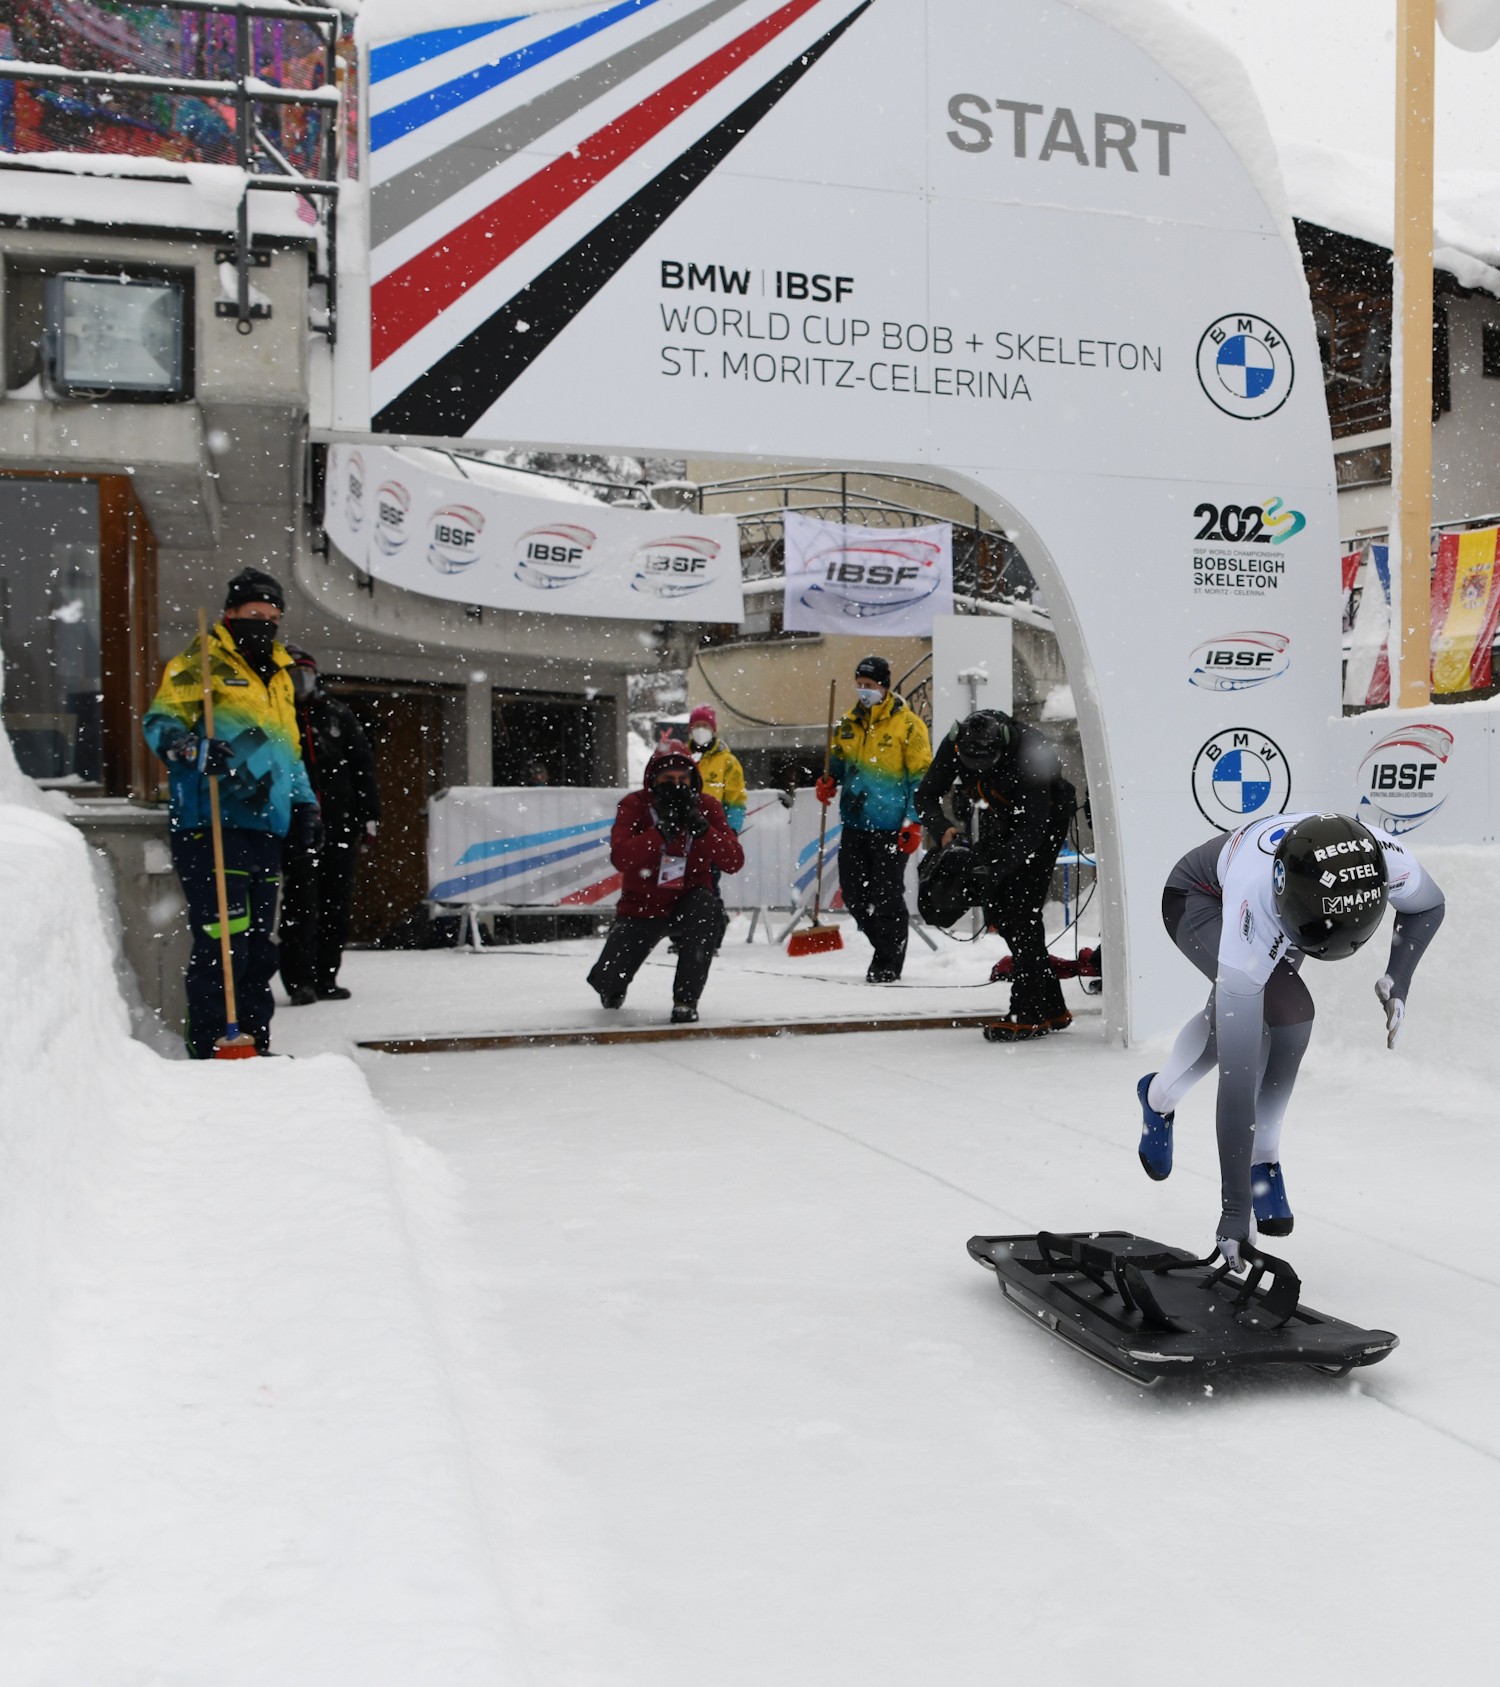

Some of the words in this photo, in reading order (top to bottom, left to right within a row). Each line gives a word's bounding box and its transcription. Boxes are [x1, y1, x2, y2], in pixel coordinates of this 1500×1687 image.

[946, 92, 1187, 177] START
[661, 260, 752, 296] BMW
[776, 270, 855, 304] IBSF
[660, 303, 791, 341] WORLD
[803, 315, 870, 347] CUP
[883, 322, 954, 354] BOB
[995, 332, 1162, 373] SKELETON
[1209, 319, 1281, 349] BMW
[661, 346, 709, 378] ST.
[723, 351, 1033, 402] MORITZ-CELERINA
[435, 524, 476, 547] IBSF
[527, 542, 583, 564] IBSF
[1209, 548, 1232, 556] WORLD
[645, 555, 709, 574] IBSF
[824, 561, 921, 586] IBSF
[1193, 556, 1285, 574] BOBSLEIGH
[1193, 572, 1278, 589] SKELETON
[1204, 588, 1229, 596] MORITZ
[1234, 589, 1266, 597] CELERINA
[1205, 650, 1275, 667] IBSF
[1205, 733, 1277, 763] BMW
[1371, 763, 1437, 790] IBSF
[1339, 863, 1379, 883] STEEL
[1268, 930, 1285, 961] BMW
